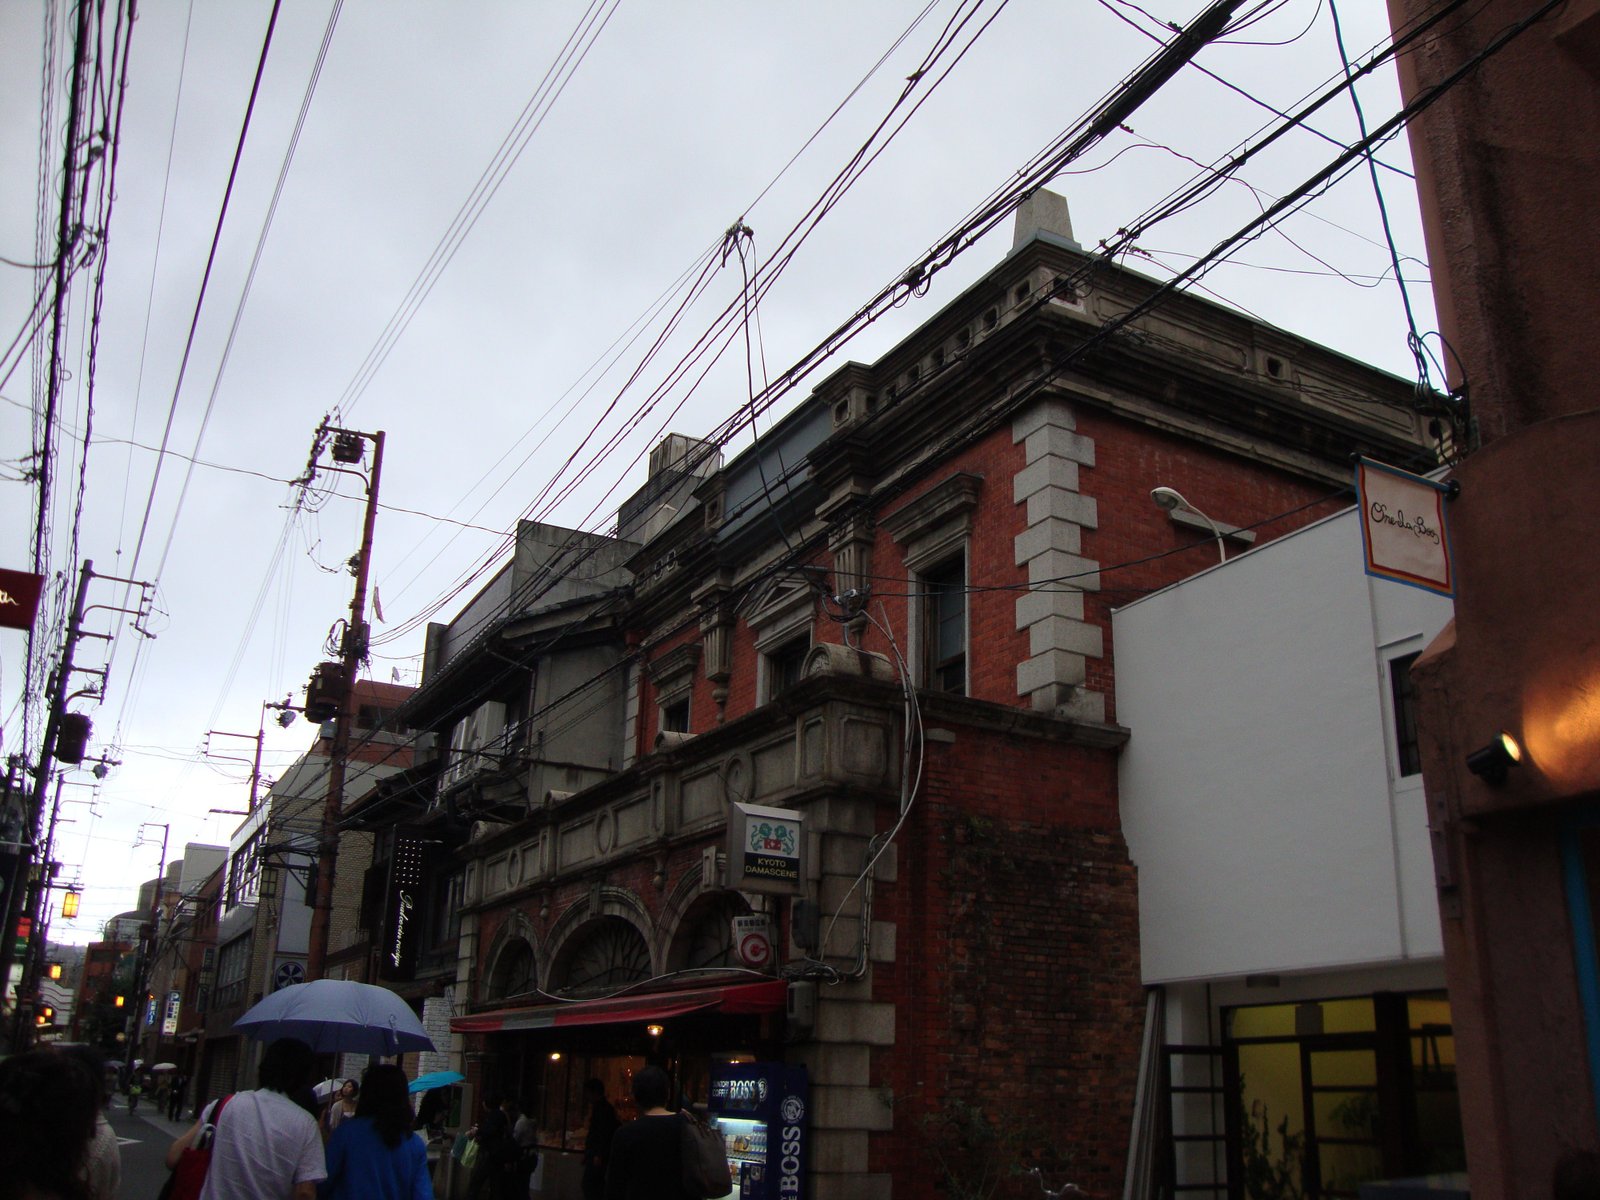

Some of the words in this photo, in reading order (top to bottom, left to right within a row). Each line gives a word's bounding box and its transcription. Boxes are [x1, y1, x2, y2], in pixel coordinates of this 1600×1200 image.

[757, 857, 786, 867] KYOTO
[745, 865, 798, 878] DAMASCENE
[730, 1080, 756, 1099] BOSS
[780, 1126, 801, 1193] BOSS
